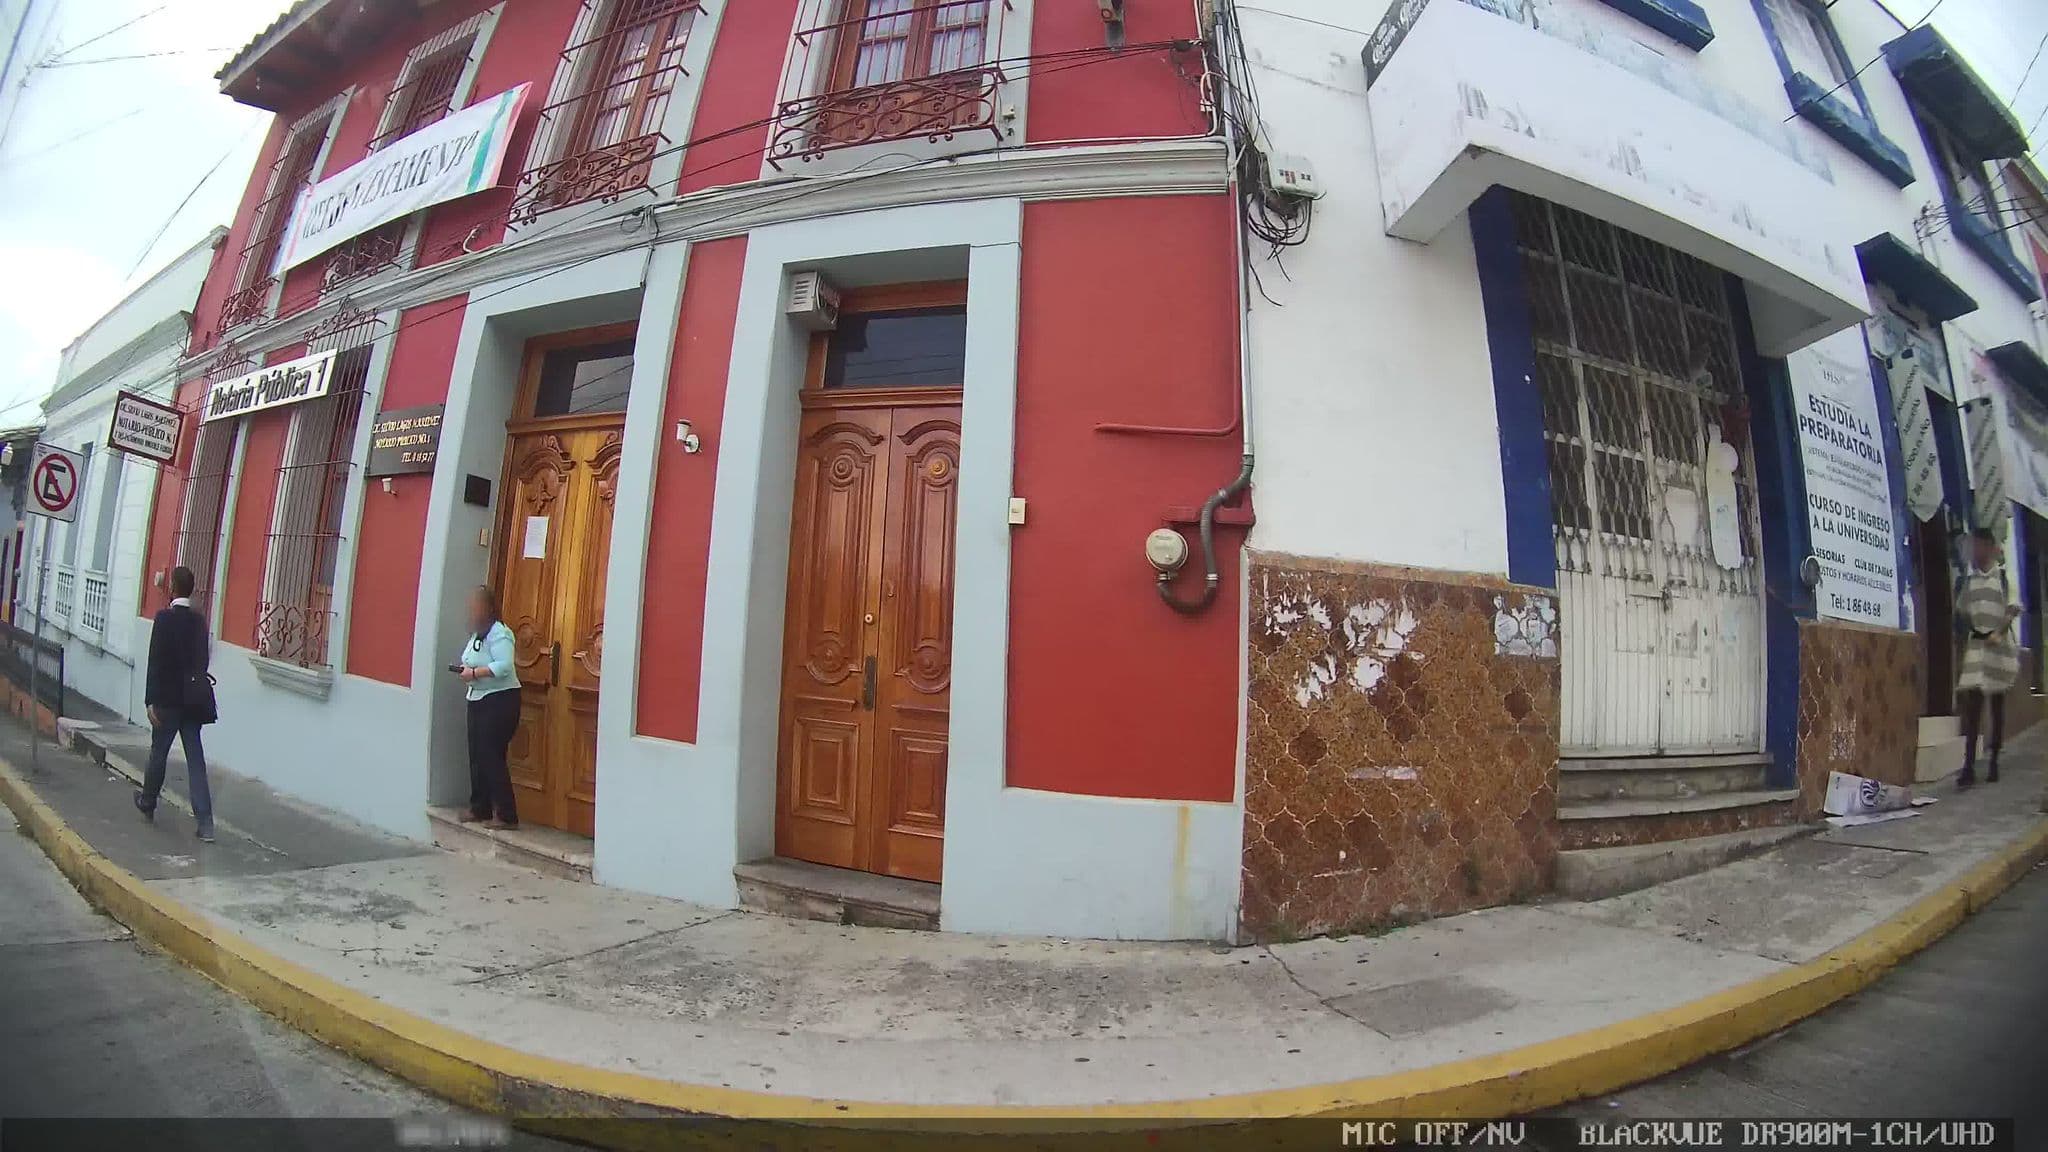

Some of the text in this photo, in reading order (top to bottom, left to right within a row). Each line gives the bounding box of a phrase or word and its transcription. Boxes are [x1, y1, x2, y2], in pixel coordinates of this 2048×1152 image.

[210, 358, 328, 416] Notaría Pública 1
[1809, 394, 1872, 439] ESTUDIA LA
[1800, 414, 1882, 466] PREPARATORIA
[1809, 494, 1890, 533] CURSO DE INGRESO
[1813, 516, 1889, 551] A LA UNIVERSIDAD
[1831, 593, 1845, 610] Tel:
